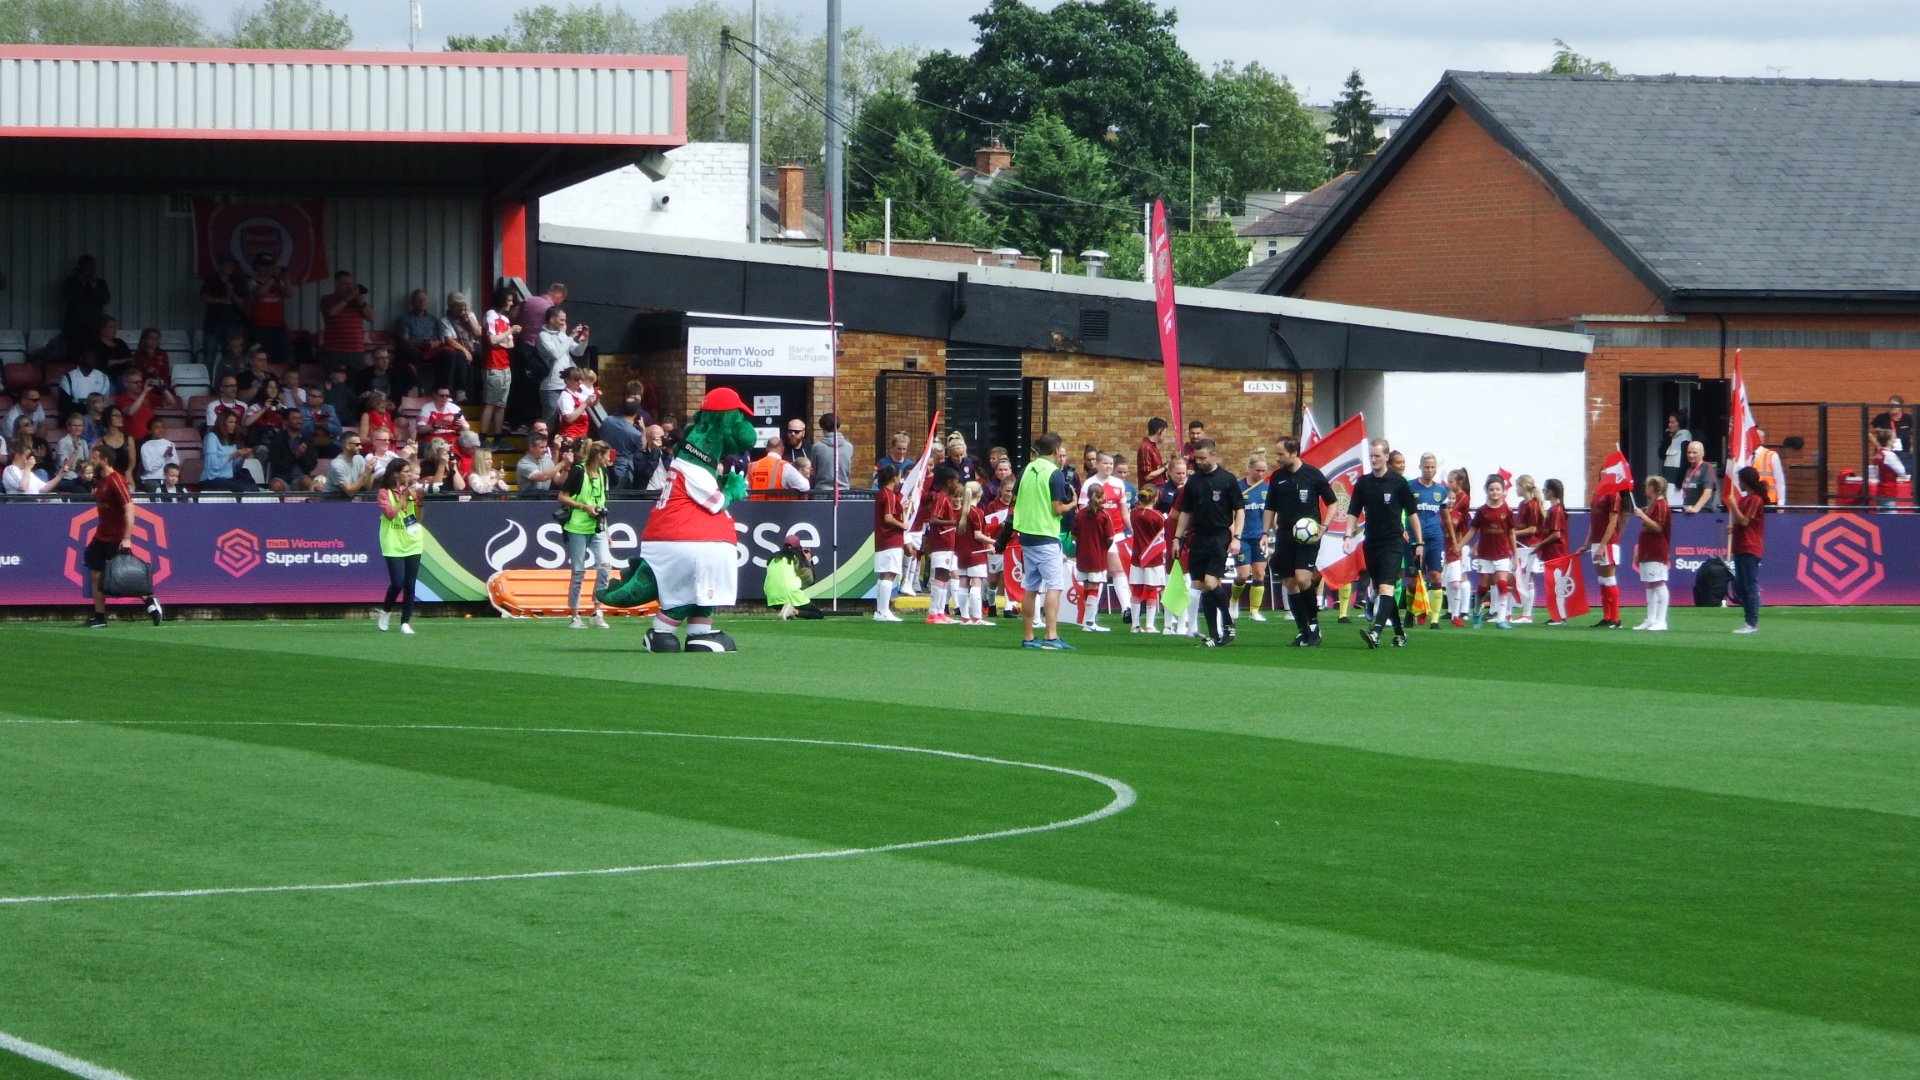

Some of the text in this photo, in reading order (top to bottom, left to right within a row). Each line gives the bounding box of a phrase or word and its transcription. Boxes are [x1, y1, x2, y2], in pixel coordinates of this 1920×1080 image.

[693, 345, 775, 357] Boreham Wood
[693, 357, 763, 368] Football Club
[788, 353, 829, 363] Southgate
[1053, 381, 1090, 390] LADIES
[1248, 383, 1282, 391] GENTS
[291, 539, 344, 549] Women's
[265, 552, 368, 567] Super League
